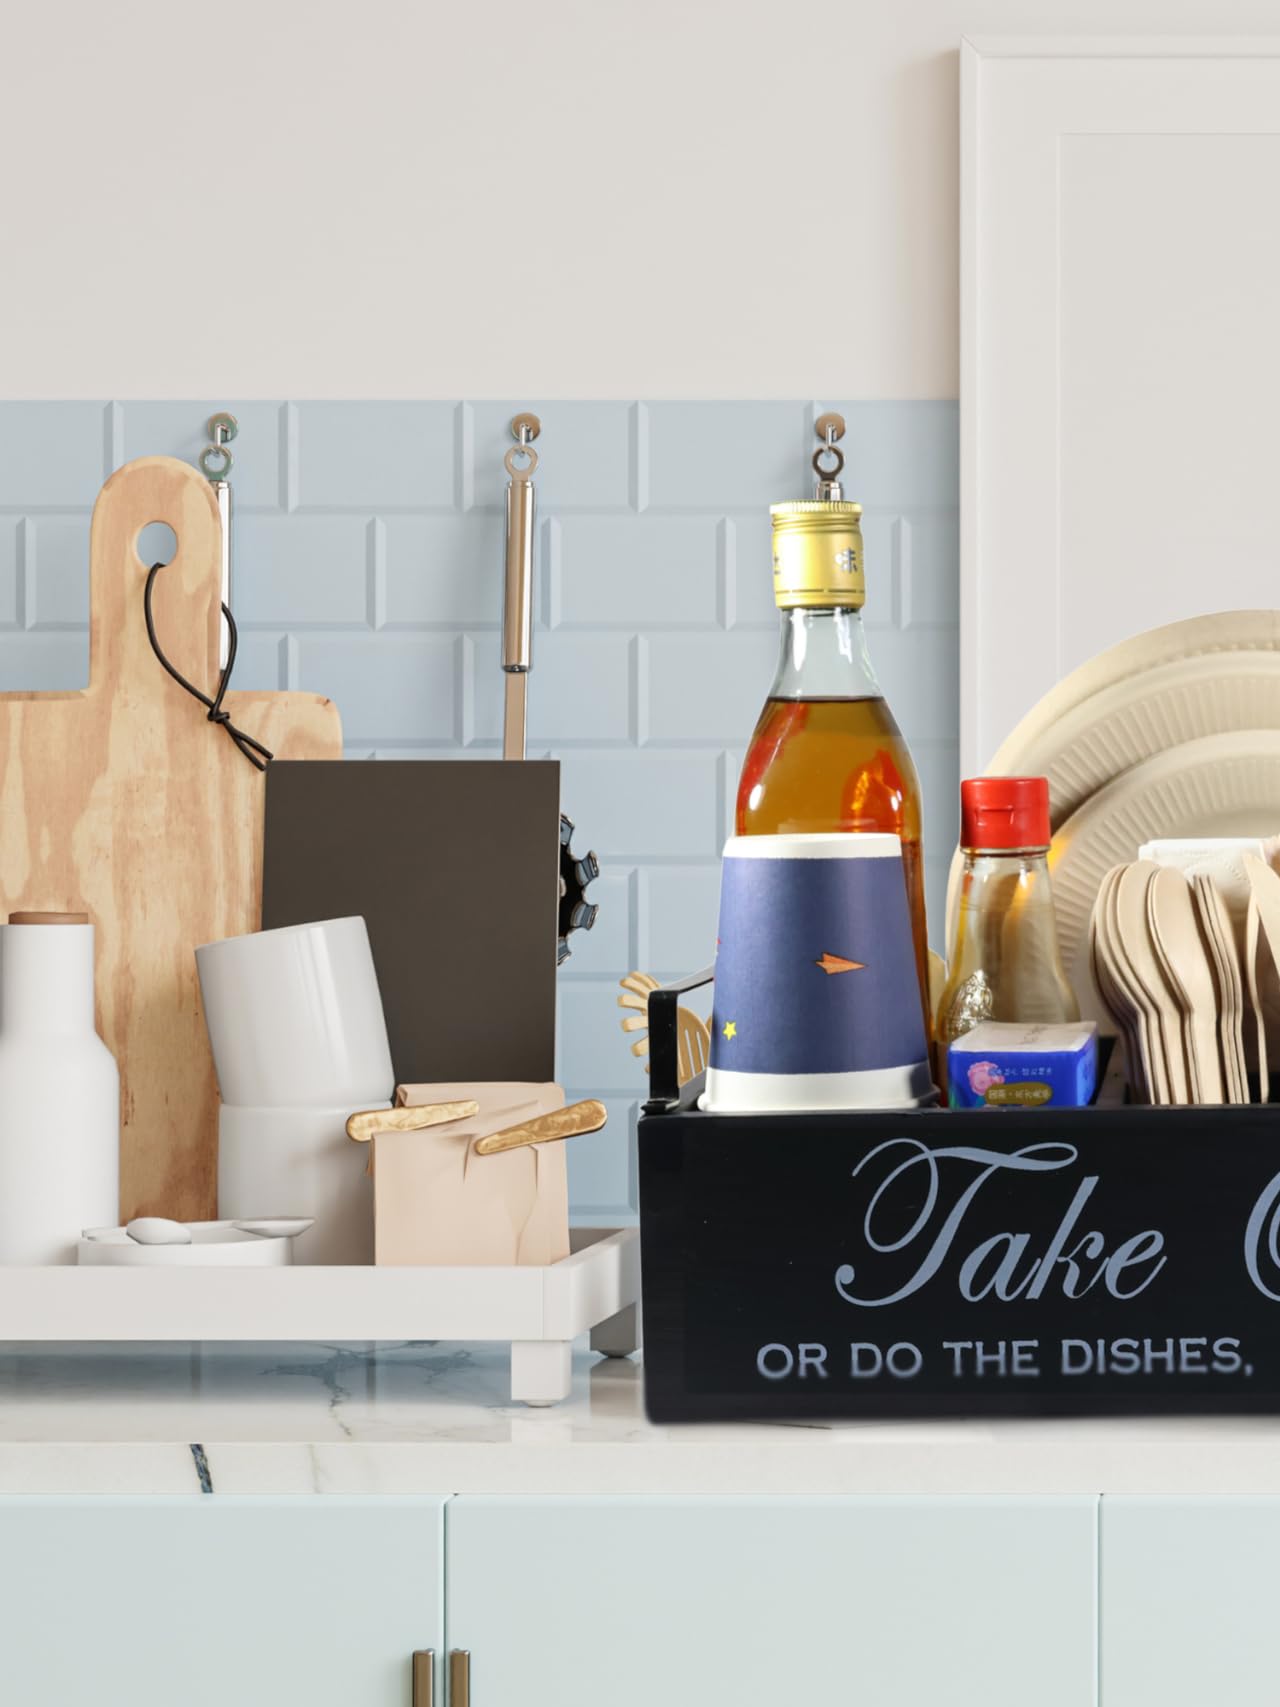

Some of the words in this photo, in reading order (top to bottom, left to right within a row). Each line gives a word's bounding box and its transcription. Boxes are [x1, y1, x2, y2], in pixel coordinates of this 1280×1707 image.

[833, 1136, 1169, 1308] Take
[756, 1341, 829, 1380] OR
[849, 1341, 924, 1379] DO
[941, 1339, 1040, 1377] THE
[1060, 1336, 1254, 1377] DISHES,
